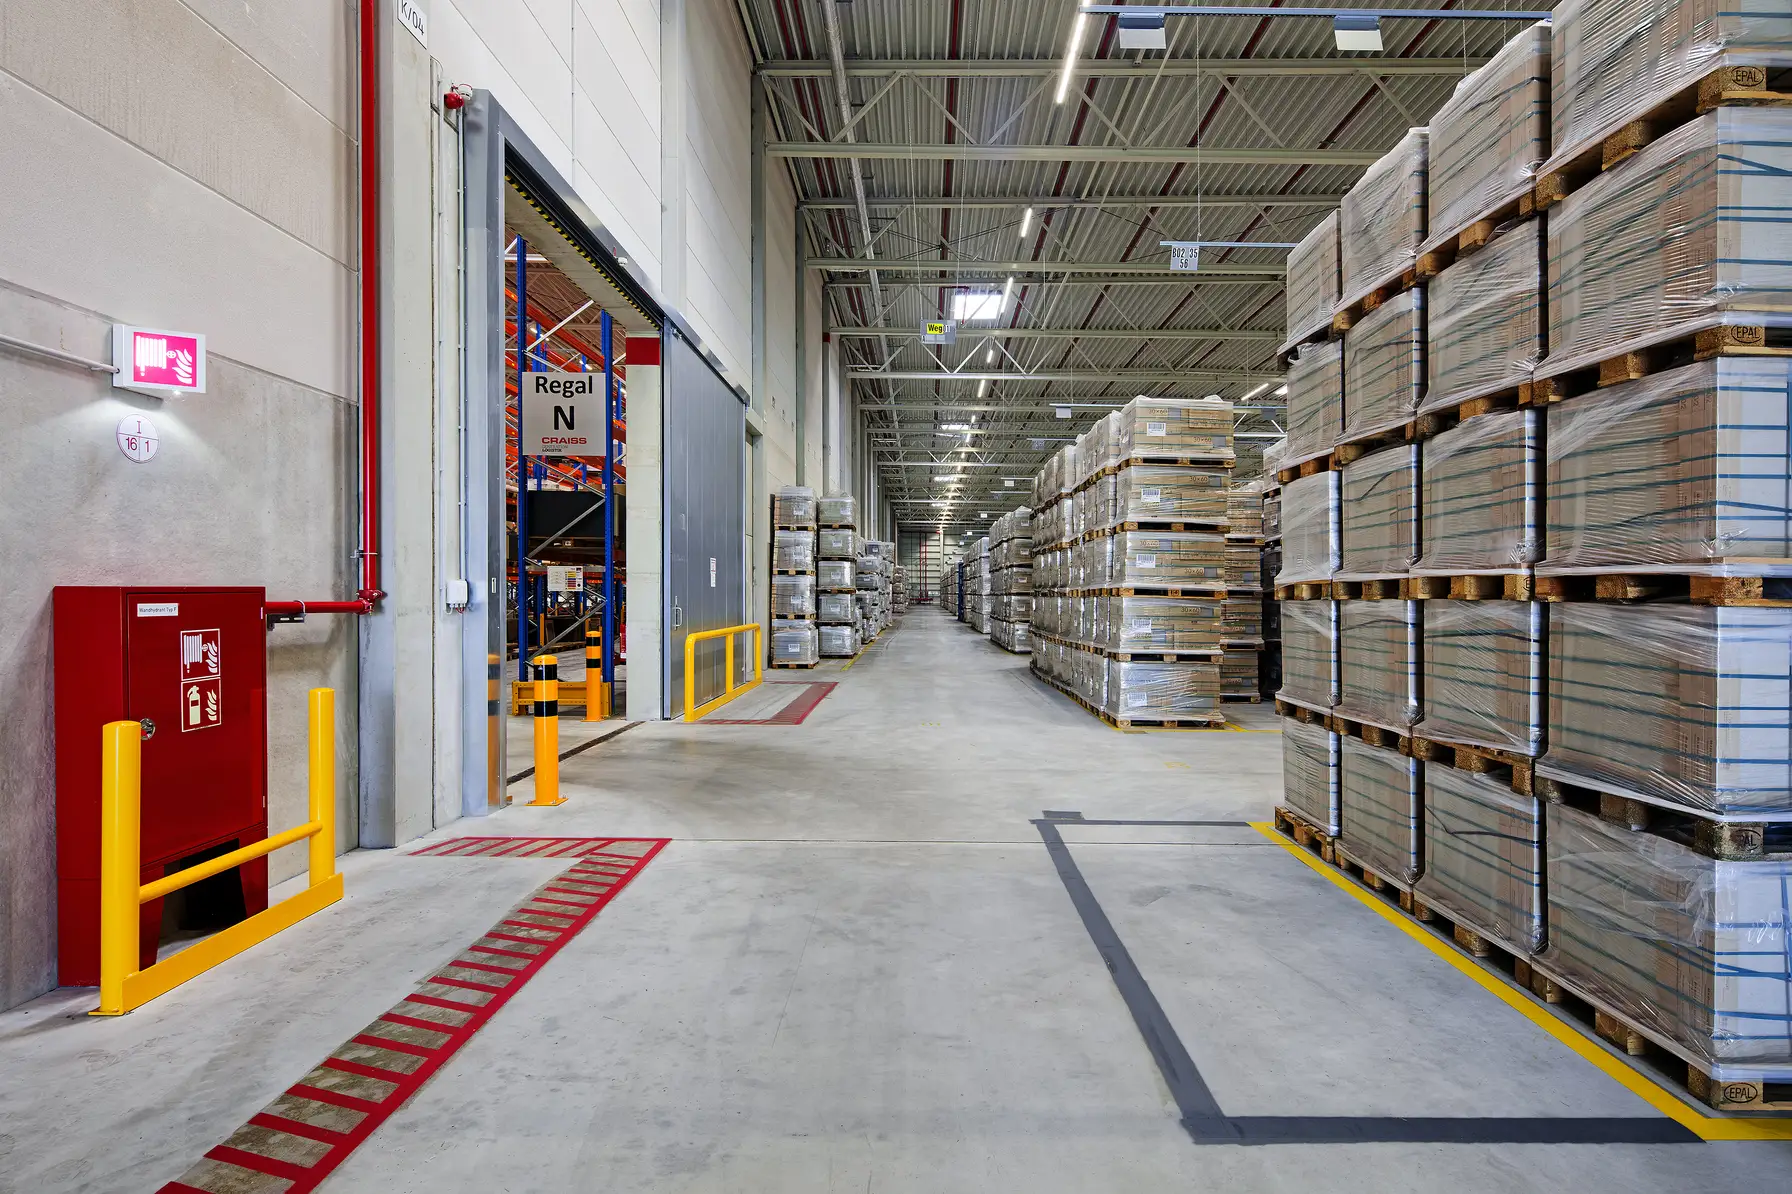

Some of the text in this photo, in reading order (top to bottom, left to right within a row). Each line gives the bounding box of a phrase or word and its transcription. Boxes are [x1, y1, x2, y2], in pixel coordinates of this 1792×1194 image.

[401, 0, 424, 36] K/04
[1735, 70, 1760, 83] EPAL
[1189, 247, 1198, 258] 35
[1180, 258, 1189, 268] 56
[927, 323, 943, 333] Weg
[1736, 326, 1760, 338] EPAL
[535, 375, 593, 398] Regal
[553, 405, 575, 431] N
[136, 420, 142, 434] I
[125, 436, 150, 453] 16 1
[541, 436, 588, 445] CRAISS
[1729, 1087, 1753, 1099] EPAL
